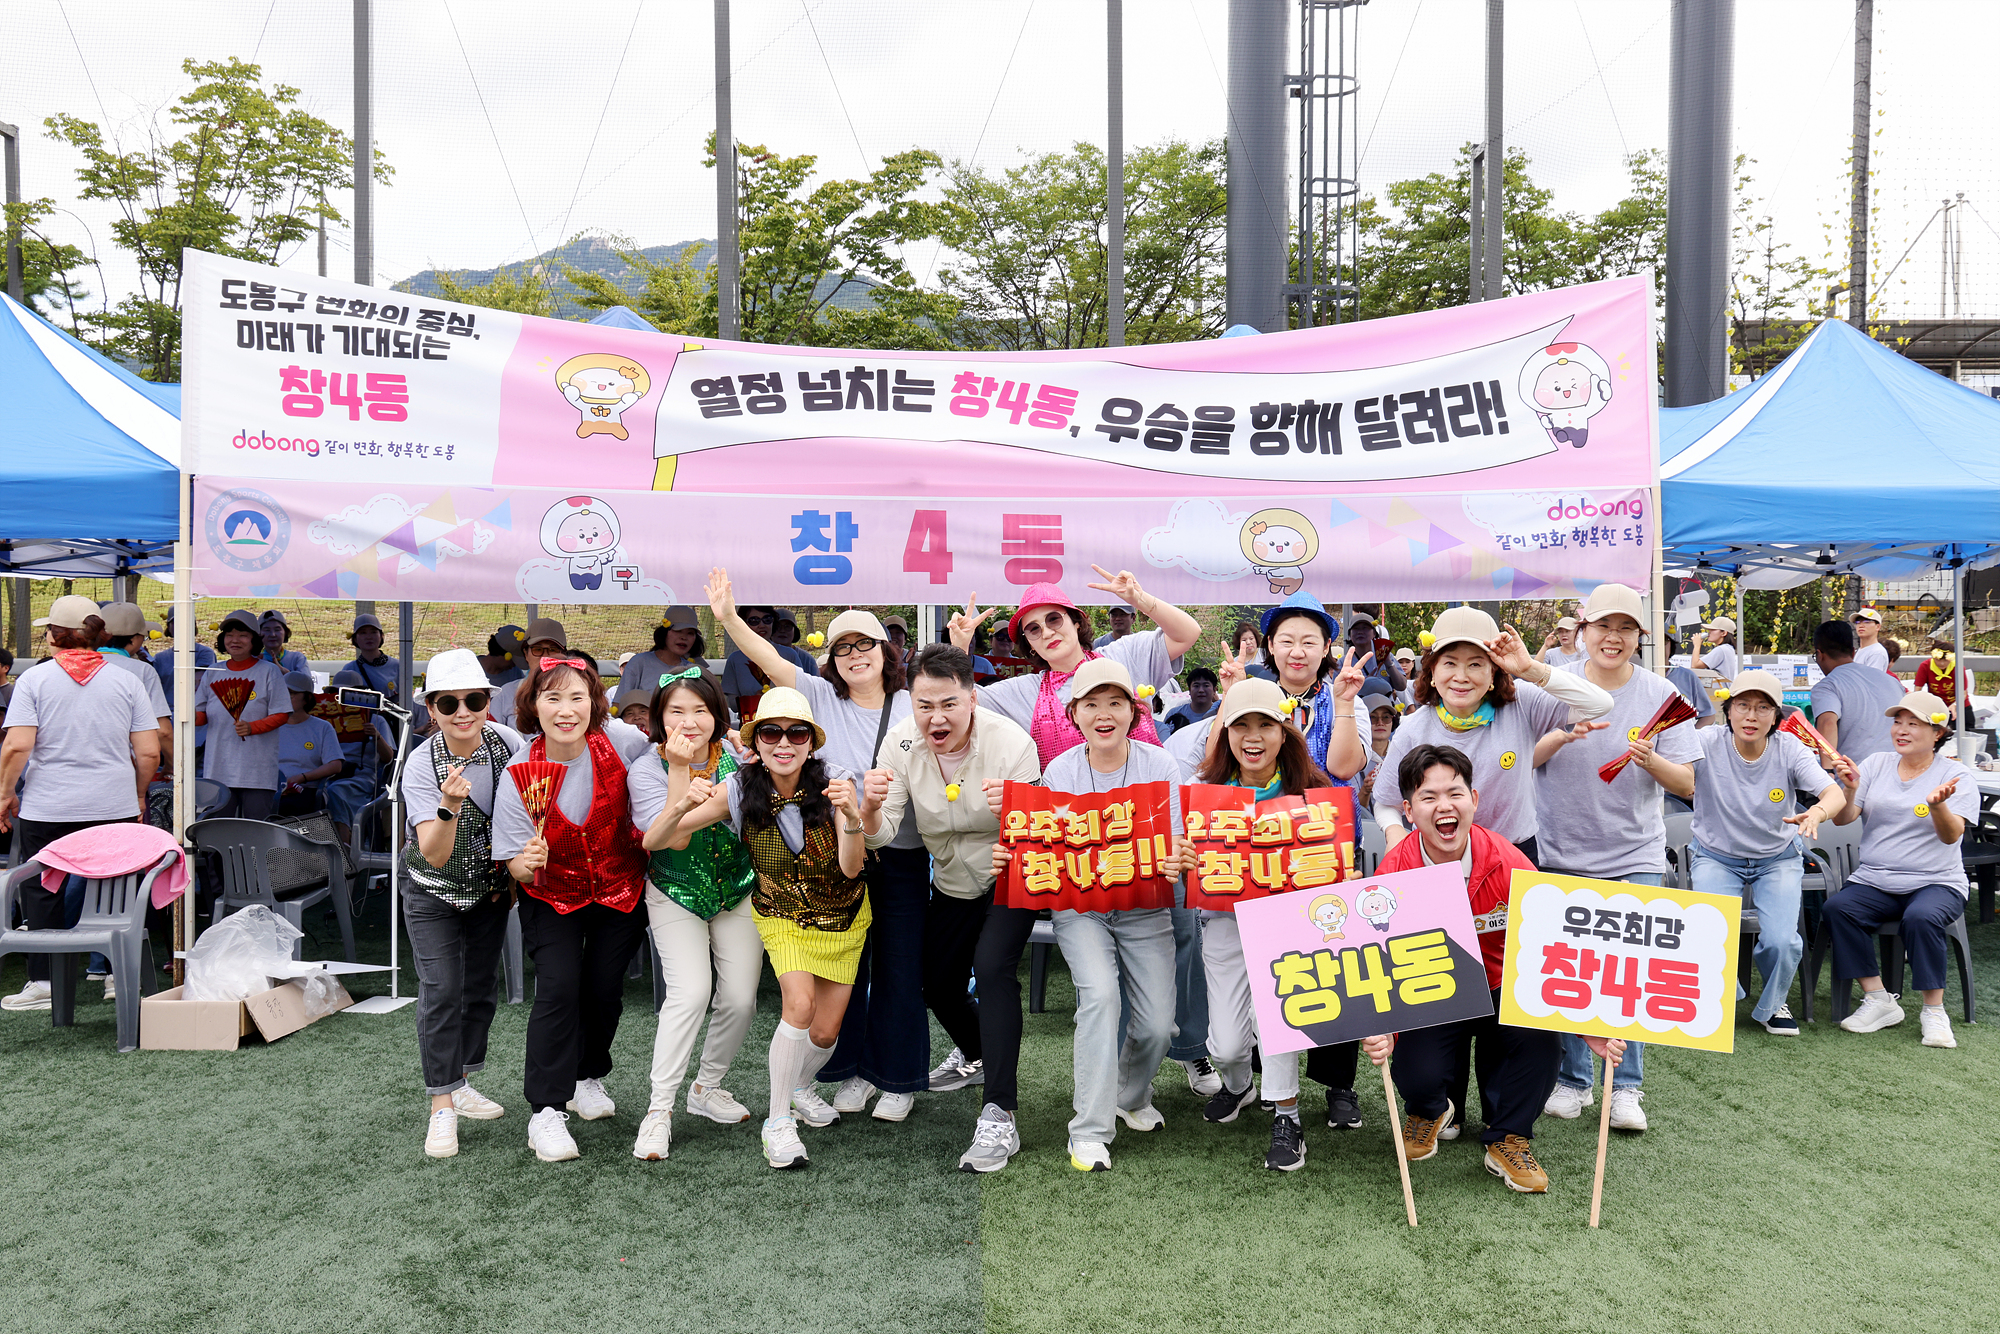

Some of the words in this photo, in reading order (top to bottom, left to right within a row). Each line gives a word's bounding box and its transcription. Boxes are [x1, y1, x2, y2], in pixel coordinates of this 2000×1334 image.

[219, 279, 308, 313] 도봉구
[315, 295, 410, 326] 변화의
[415, 308, 481, 340] 중심,
[236, 319, 326, 354] 미래가
[332, 324, 451, 361] 기대되는
[279, 364, 410, 422] 창4동
[690, 371, 787, 419] 열정
[797, 365, 936, 413] 넘치는
[948, 370, 1080, 438] 창4동,
[1095, 397, 1237, 457] 우승을
[1249, 399, 1344, 456] 향해
[1354, 378, 1510, 452] 달려라!
[232, 429, 320, 457] dobong
[324, 440, 349, 455] 같이
[353, 440, 383, 458] 변화,
[387, 441, 430, 459] 행복한
[432, 444, 455, 461] 도봉
[207, 494, 232, 522] Dobong
[230, 489, 260, 500] Sports
[261, 495, 289, 525] Council
[1547, 498, 1643, 521] dobong
[790, 509, 859, 586] 창
[902, 509, 954, 585] 4
[1001, 513, 1065, 586] 동
[1495, 535, 1526, 550] 같이
[1531, 529, 1567, 550] 변화,
[1572, 525, 1617, 547] 행복한
[1623, 524, 1644, 546] 도봉
[1002, 799, 1136, 848] 우주최강
[1563, 904, 1686, 950] 우주최강
[1272, 929, 1457, 1028] 창4동
[1540, 941, 1700, 1023] 창4동
